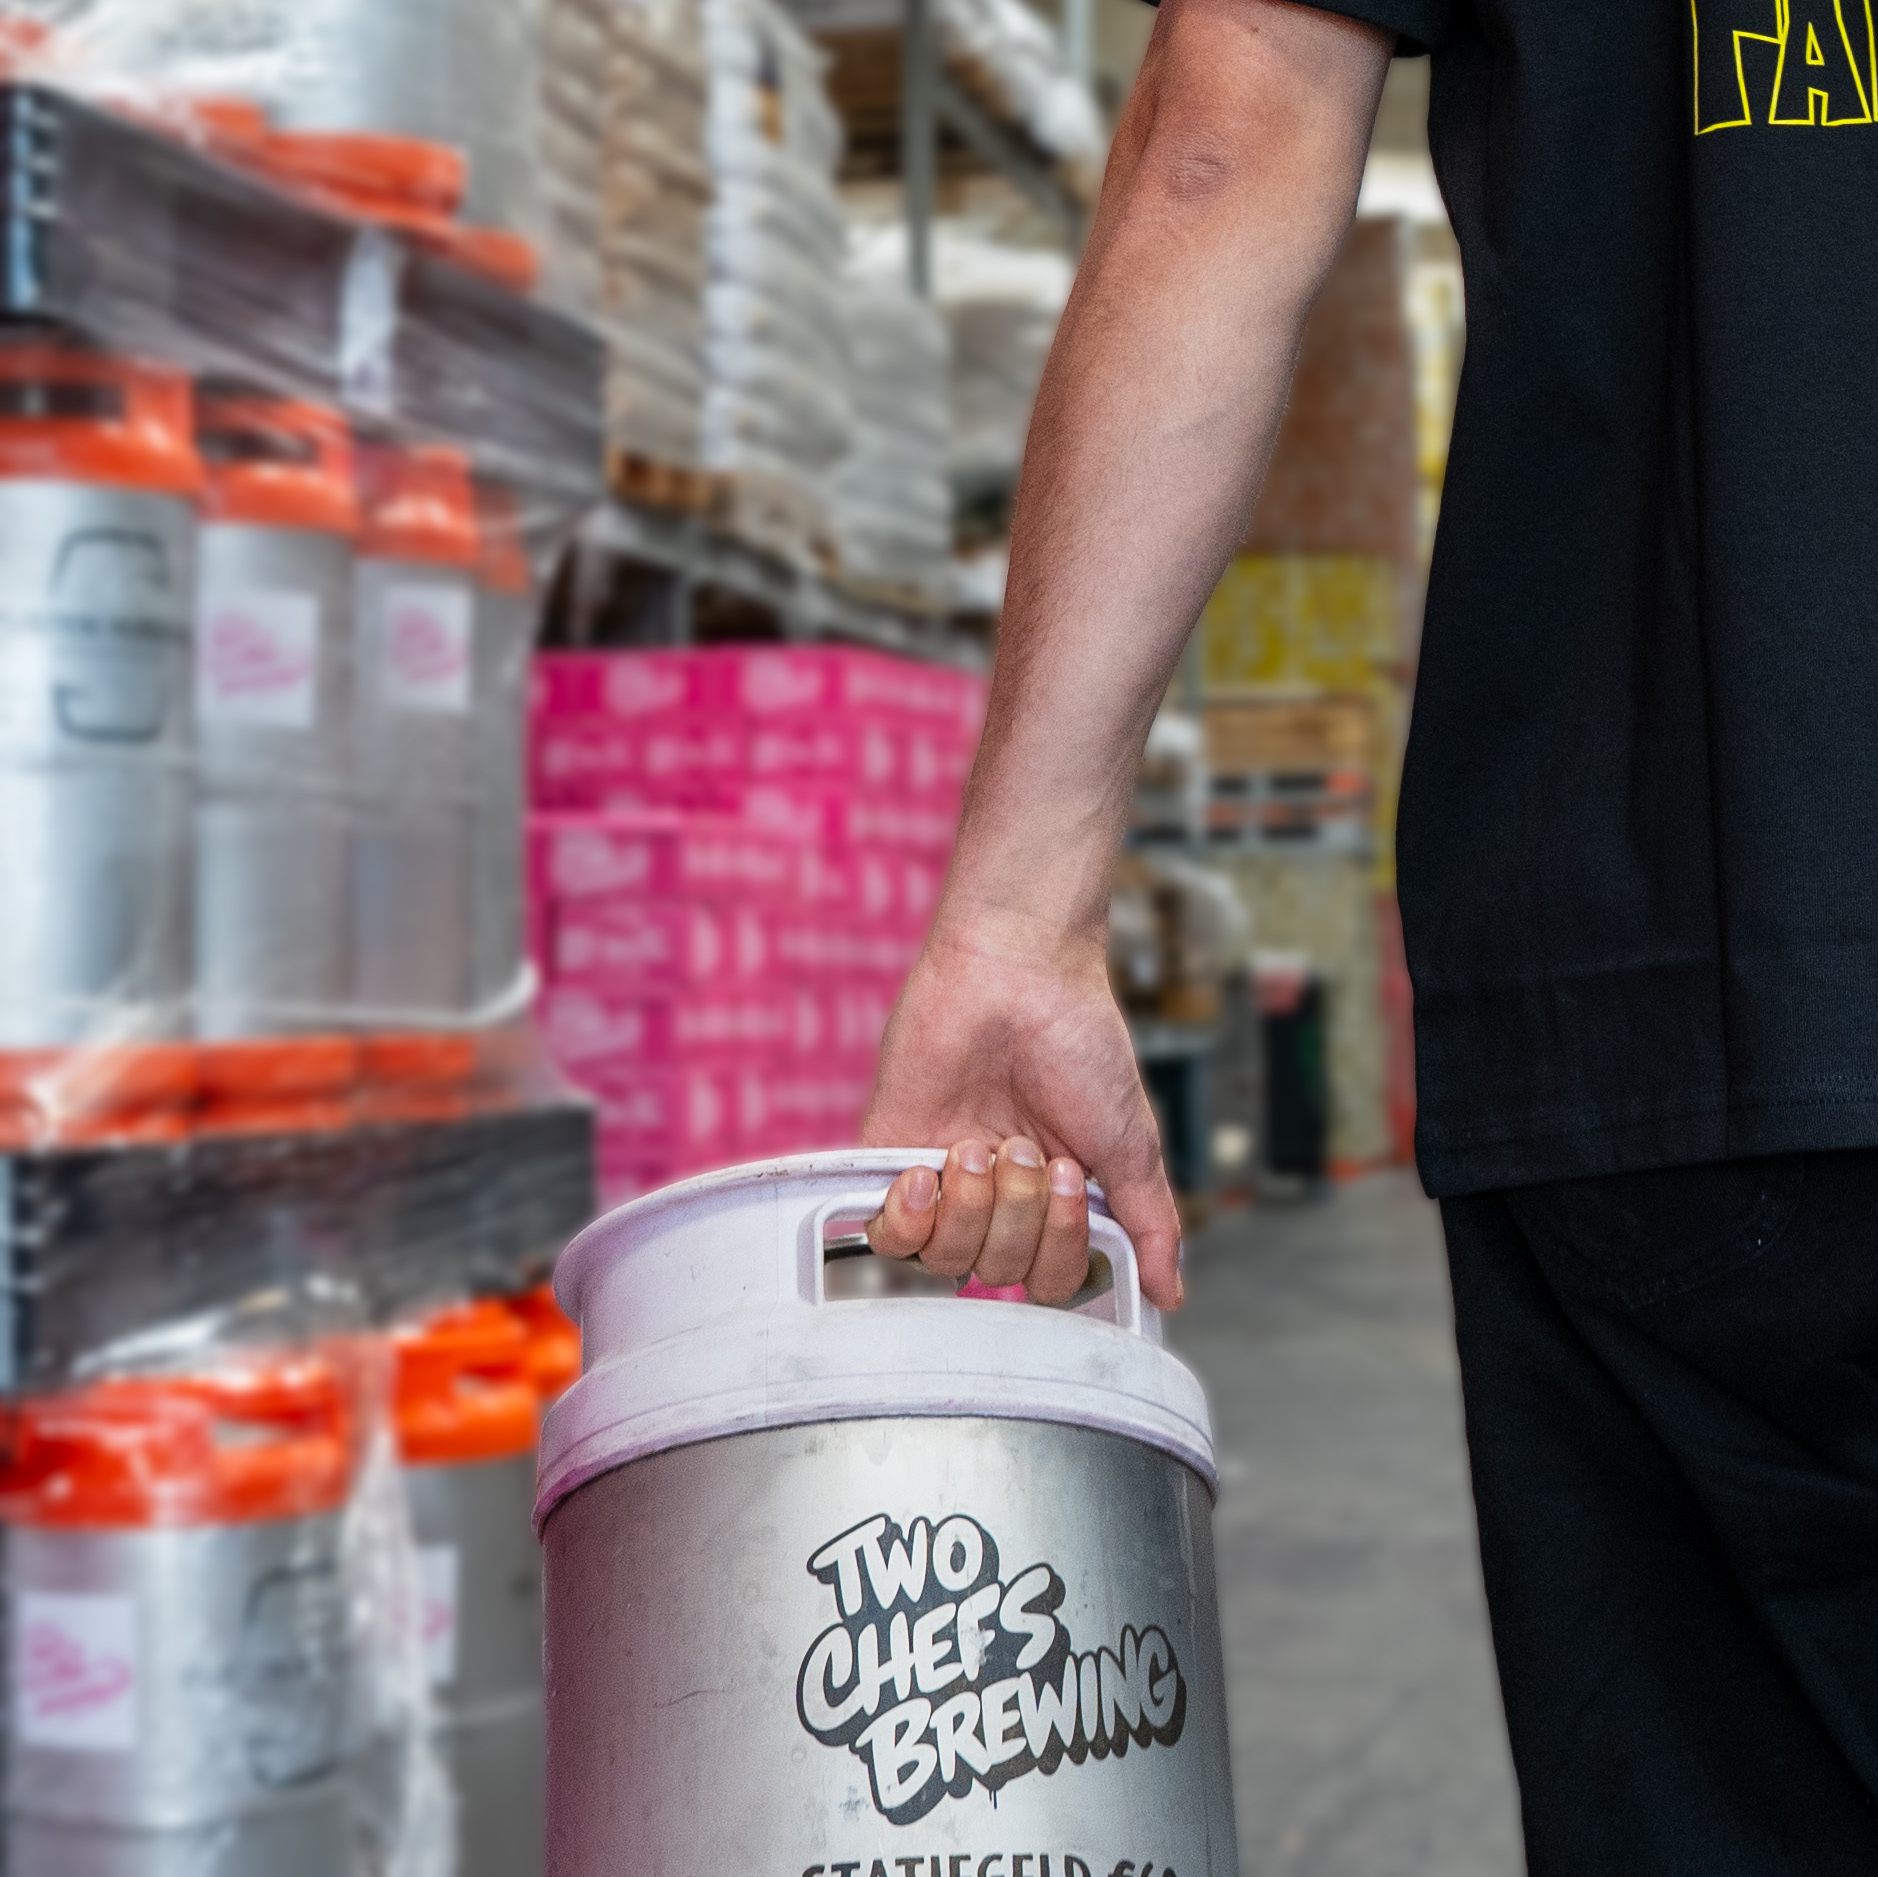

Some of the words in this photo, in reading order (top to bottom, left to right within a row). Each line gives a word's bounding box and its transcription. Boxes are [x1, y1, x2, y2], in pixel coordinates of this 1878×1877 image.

[796, 1562, 1068, 1748] CHEFS
[807, 1513, 1000, 1621] TWO
[851, 1624, 1187, 1825] BREWING
